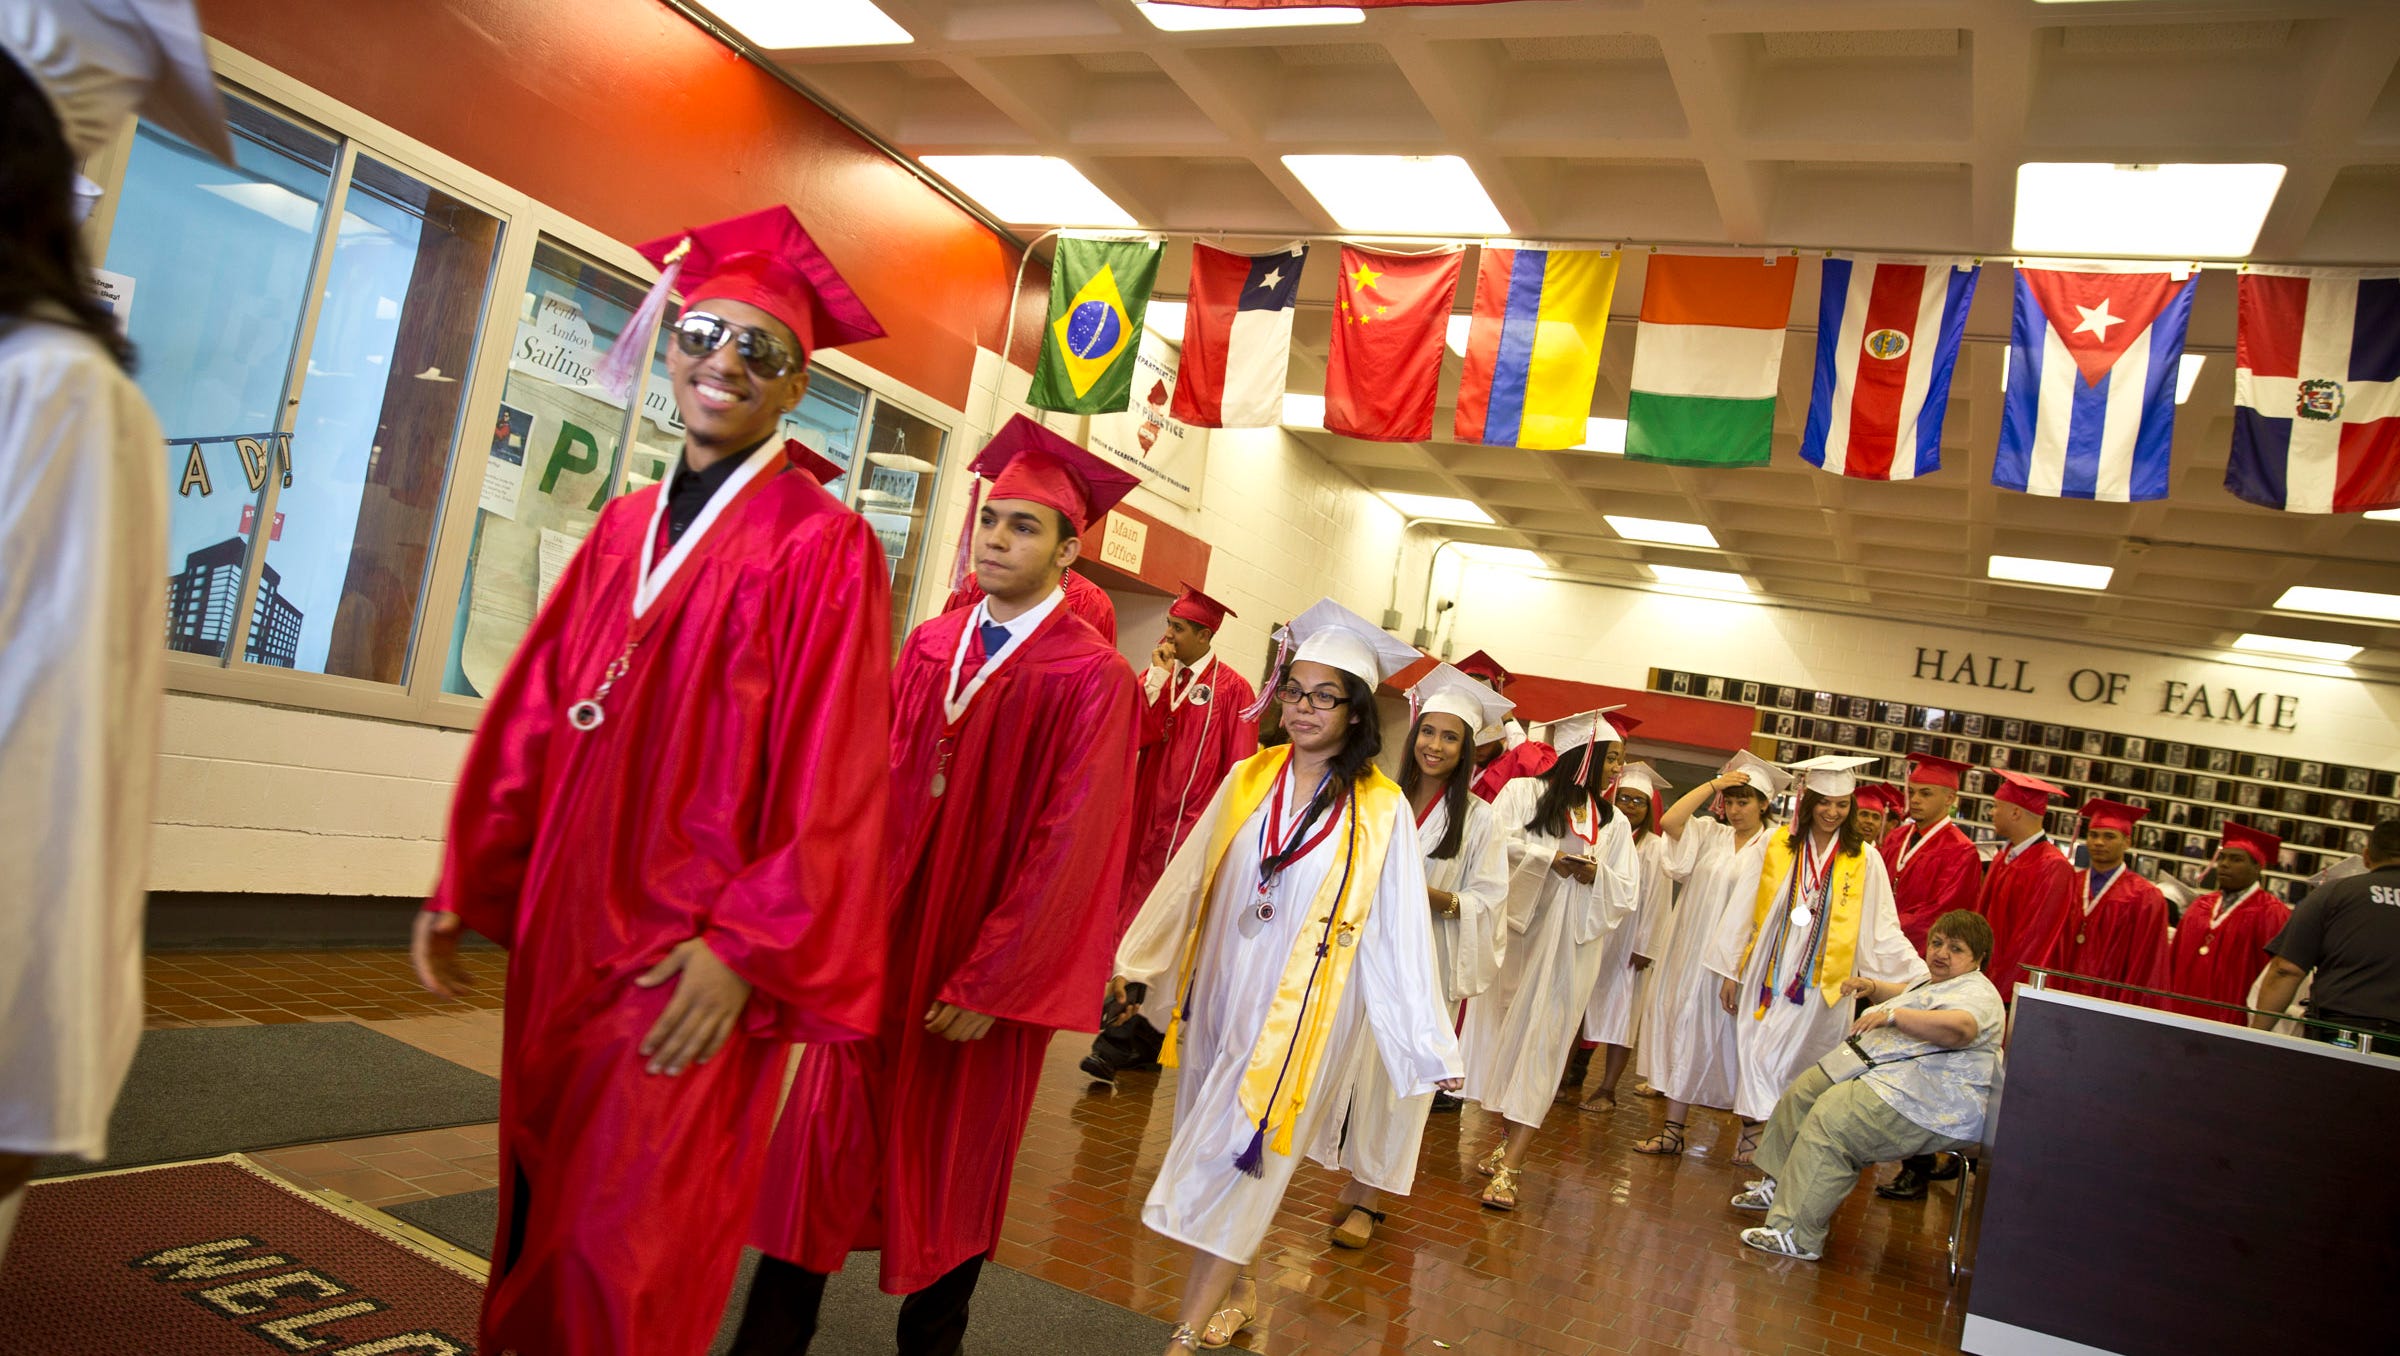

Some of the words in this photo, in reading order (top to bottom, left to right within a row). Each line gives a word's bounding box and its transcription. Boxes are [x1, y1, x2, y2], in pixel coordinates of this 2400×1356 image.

[544, 299, 578, 323] Perth
[546, 323, 592, 351] Amboy
[516, 335, 596, 386] Sailing
[1112, 519, 1139, 543] Main
[1106, 540, 1138, 565] Office
[1912, 646, 2036, 695] HALL
[2068, 668, 2131, 706] OF
[2160, 680, 2301, 732] FAME
